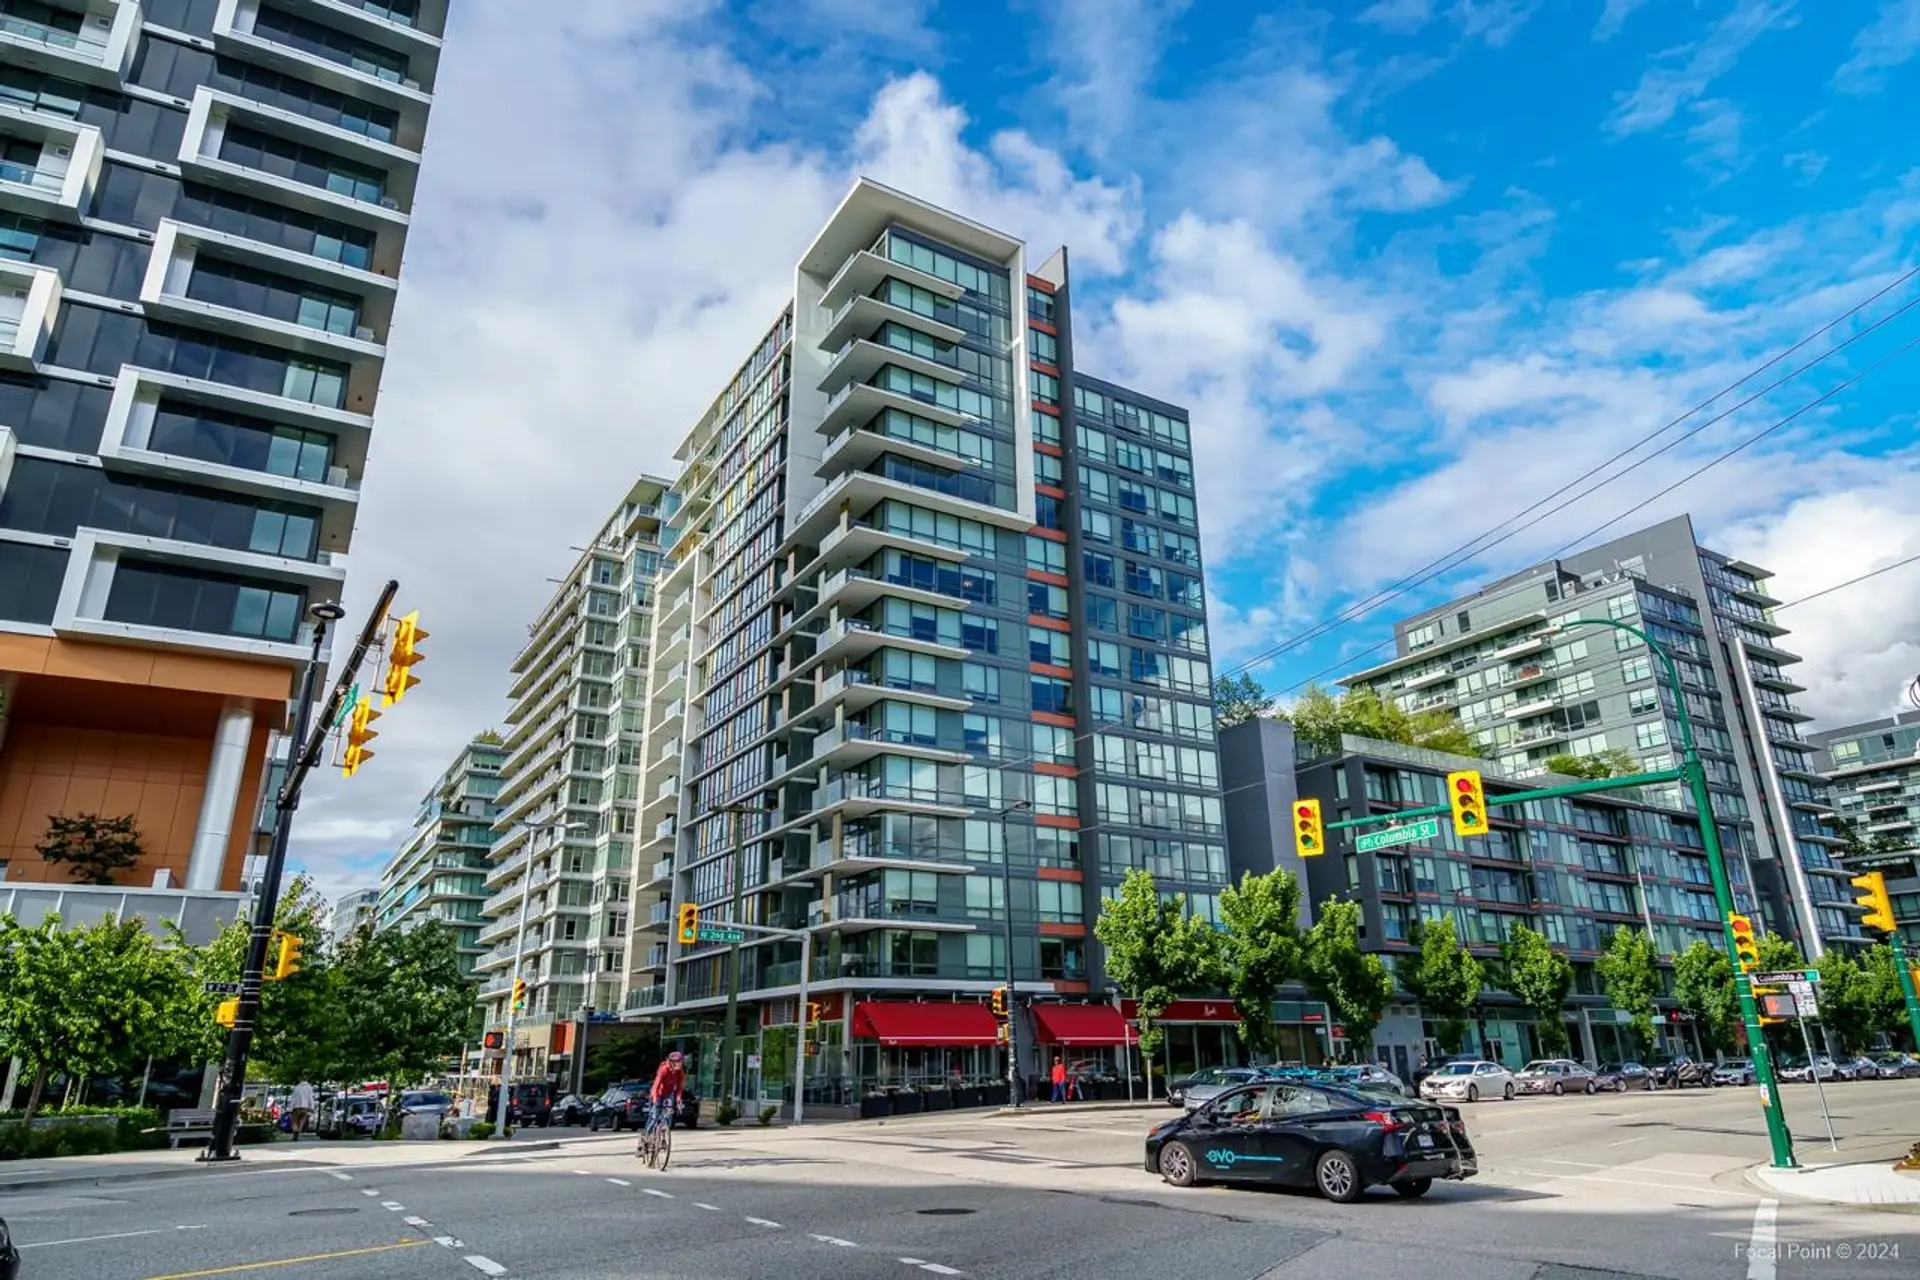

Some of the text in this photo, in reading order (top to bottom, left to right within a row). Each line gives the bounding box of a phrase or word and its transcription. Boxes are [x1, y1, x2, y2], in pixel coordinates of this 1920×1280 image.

[1375, 824, 1430, 846] Columbia St
[700, 931, 742, 941] W 2nd Ave
[1206, 1148, 1236, 1164] evo
